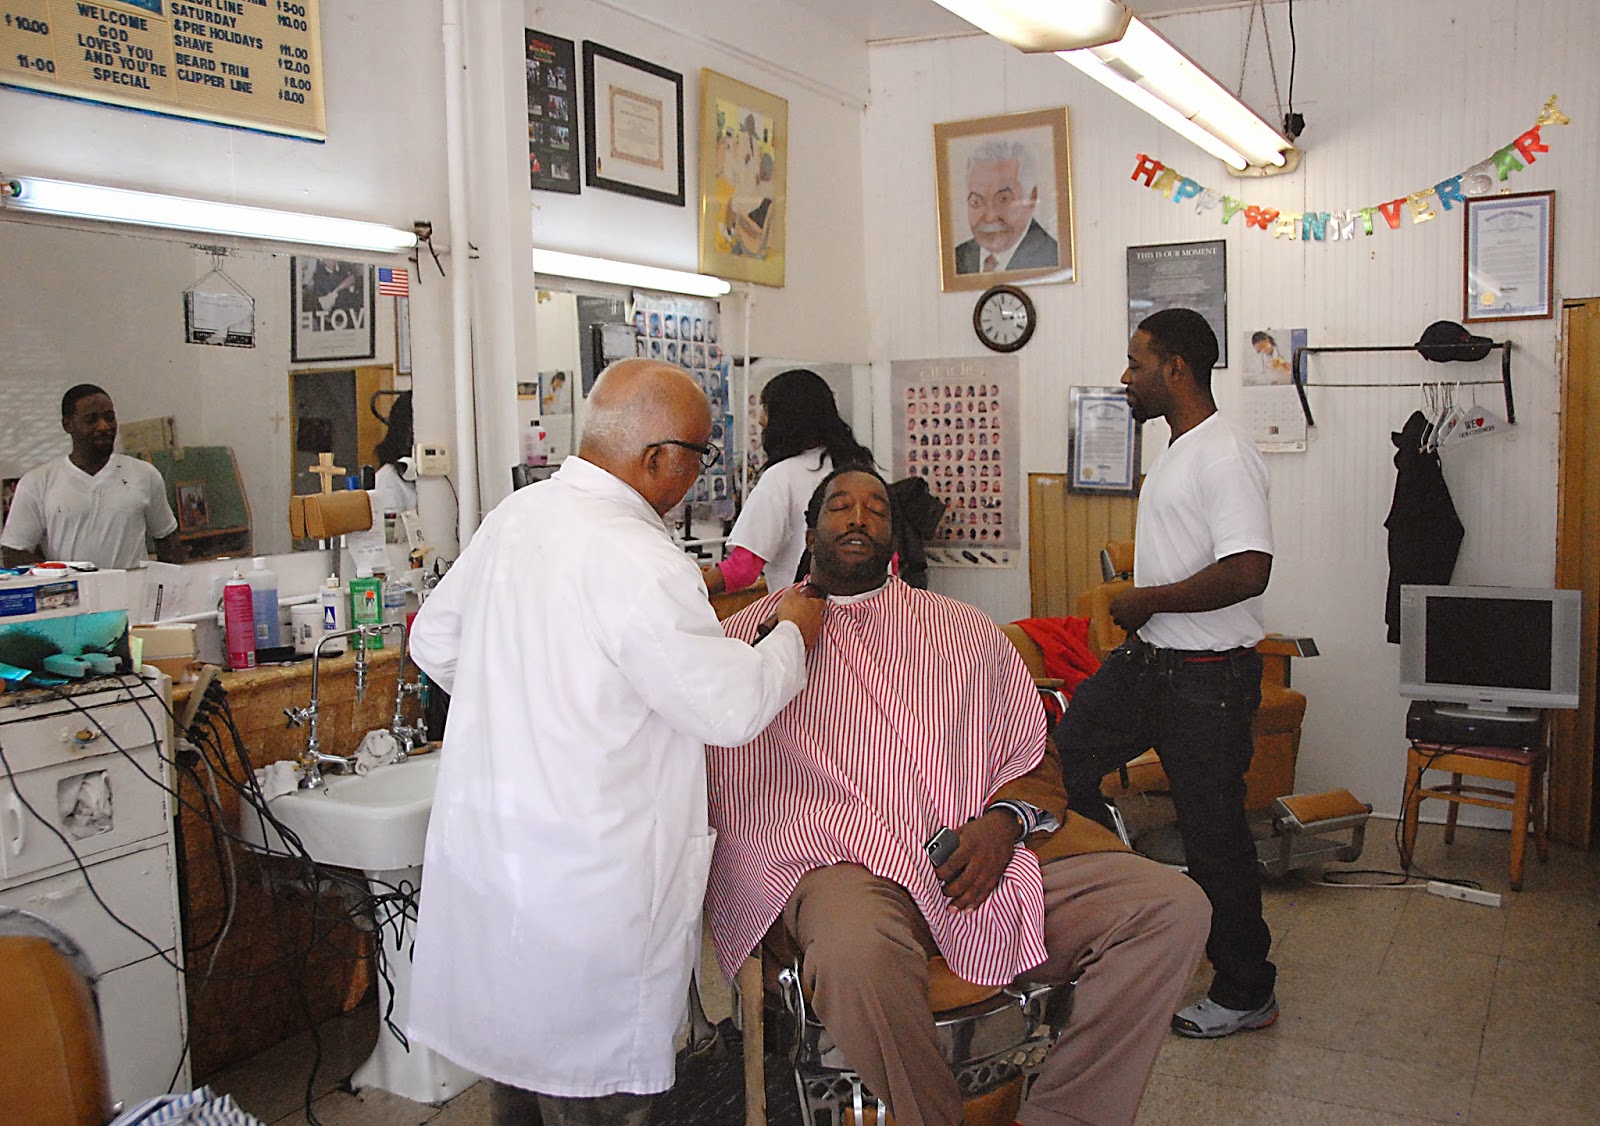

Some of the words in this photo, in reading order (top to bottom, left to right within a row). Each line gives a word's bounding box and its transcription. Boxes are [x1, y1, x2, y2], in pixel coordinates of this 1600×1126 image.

[77, 3, 148, 31] WELCOME
[171, 3, 237, 28] SATURDAY
[217, 0, 244, 15] LINE
[98, 24, 129, 42] GOD
[174, 34, 214, 54] SHAVE
[209, 26, 263, 50] HOLIDAYS
[77, 33, 121, 54] LOVES
[126, 44, 153, 61] YOU
[85, 49, 113, 66] AND
[119, 56, 167, 77] YOU'RE
[175, 52, 216, 71] BEARD
[220, 62, 249, 79] TRIM
[93, 67, 151, 90] SPECIAL
[177, 68, 225, 89] CLIPPER
[230, 79, 253, 94] LINE
[1131, 152, 1249, 225] HAPPY
[1272, 94, 1571, 241] ANNIVERSARY
[1136, 252, 1154, 260] THIS
[1163, 250, 1180, 258] OUR
[1181, 248, 1217, 256] MOMENT
[1464, 420, 1476, 430] WE
